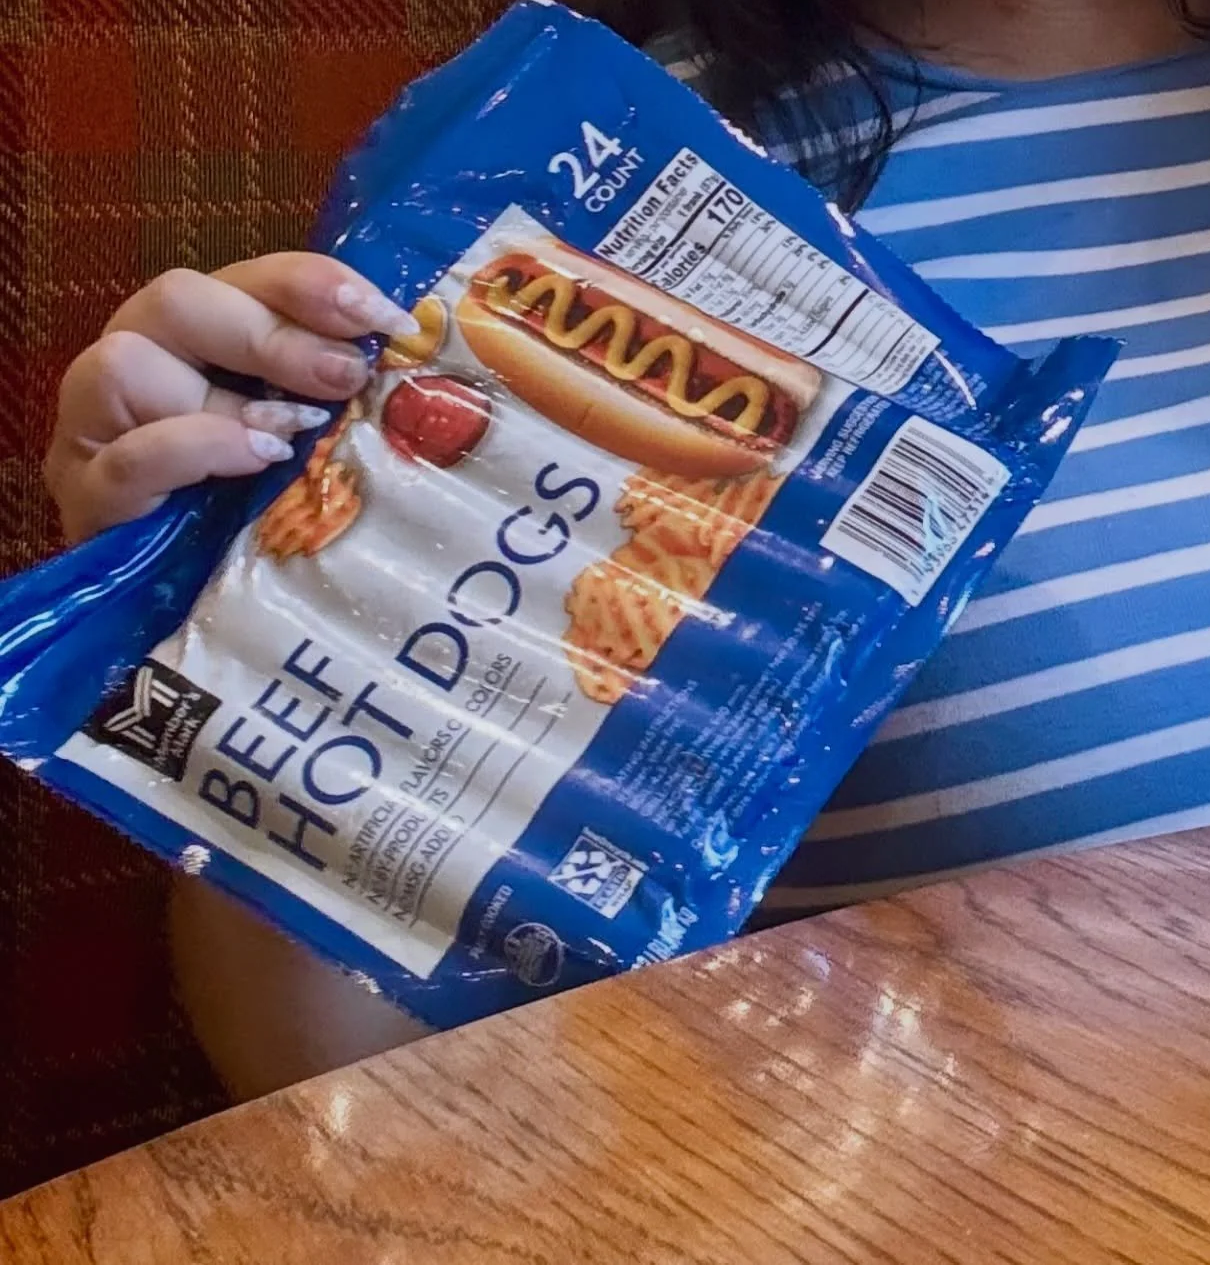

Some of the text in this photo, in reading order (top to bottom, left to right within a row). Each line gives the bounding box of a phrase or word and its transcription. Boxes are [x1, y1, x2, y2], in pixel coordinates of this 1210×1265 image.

[548, 122, 623, 199] 24
[584, 147, 645, 213] COUNT
[598, 194, 663, 259] Nutrition
[655, 151, 699, 196] Facts
[706, 188, 744, 225] 170
[266, 461, 602, 872] HOT DOGS
[199, 638, 344, 830] BEEF
[350, 793, 407, 868] ARTIFICIA
[401, 733, 452, 795] FLAVORS
[464, 652, 514, 714] COLORS
[378, 785, 449, 885] BY-PRODUTS
[419, 812, 466, 863] ADD
